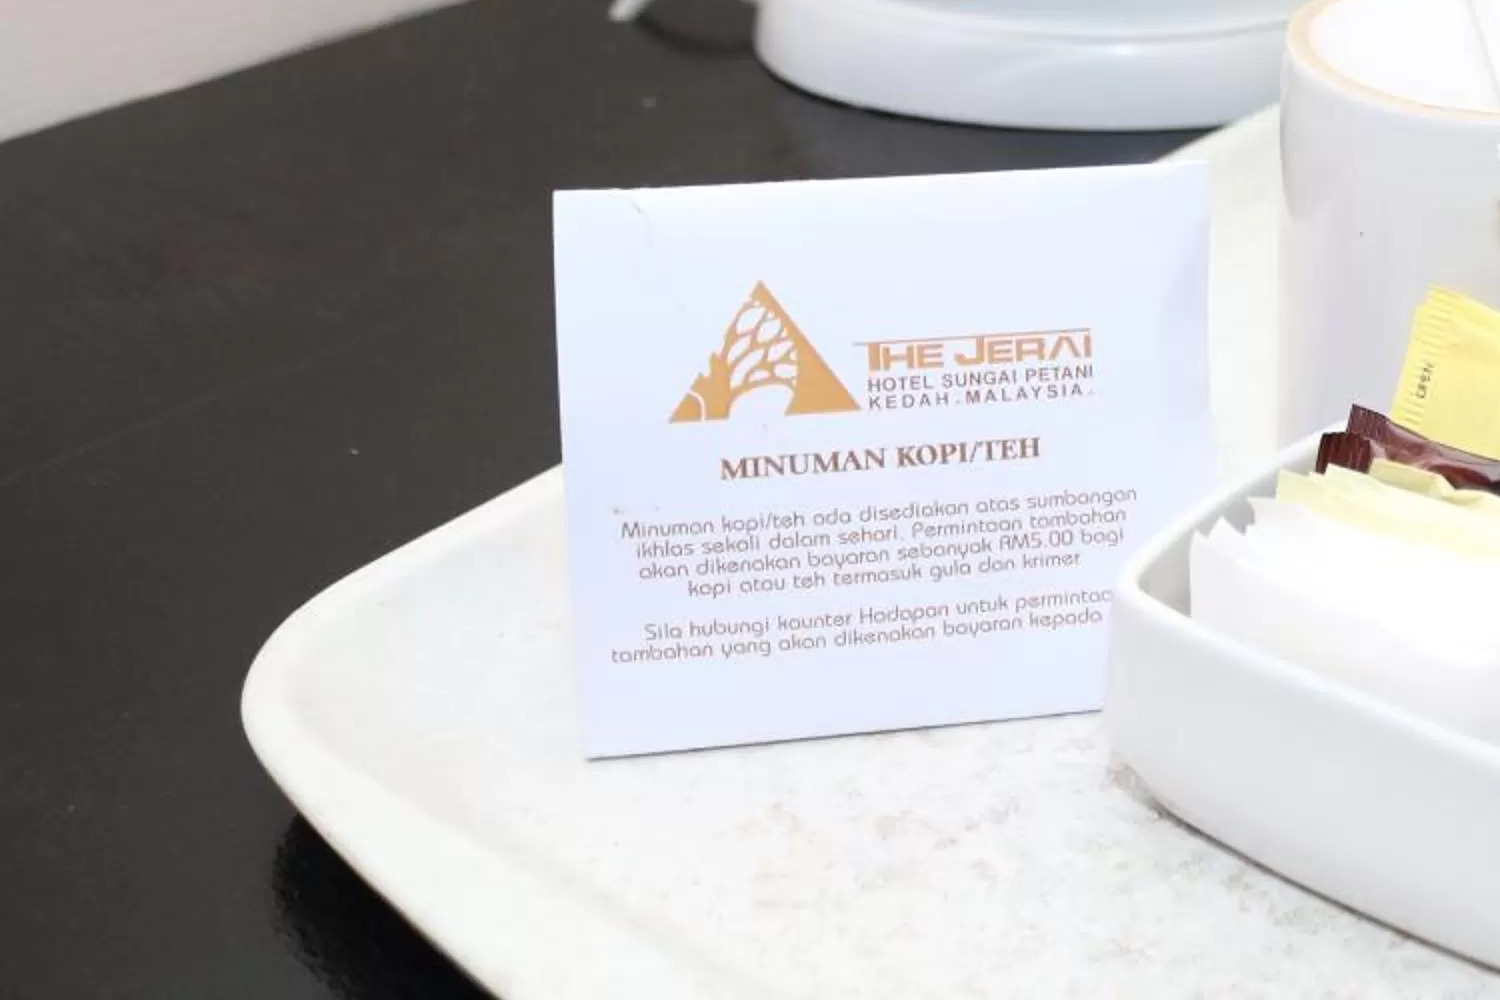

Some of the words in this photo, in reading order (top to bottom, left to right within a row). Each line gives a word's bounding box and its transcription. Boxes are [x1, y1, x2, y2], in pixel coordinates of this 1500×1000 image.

[866, 339, 945, 372] THE
[954, 333, 1091, 366] JERAI
[868, 376, 933, 393] HOTEL
[942, 370, 1016, 389] SUNGAI
[1025, 364, 1093, 383] PETANI
[720, 447, 887, 480] MINUMAN
[897, 437, 1040, 468] KOPI/TEH
[621, 520, 714, 540] Minuman
[722, 512, 805, 535] kopi/teh
[813, 508, 851, 525] ada
[859, 500, 969, 523] disediakan
[976, 497, 1020, 512] atas
[1027, 488, 1137, 510] sumbangan
[636, 539, 694, 559] ikhlas
[701, 535, 761, 555] sekali
[768, 532, 831, 549] dalam
[911, 520, 1022, 539] Permintaan
[1030, 508, 1126, 529] tambahan
[639, 562, 689, 580] akan
[695, 553, 801, 576] dikenakan
[807, 548, 890, 569] bayaran
[897, 536, 992, 560] sebanyak
[999, 529, 1073, 551] RM5.00
[1081, 527, 1124, 547] bagi
[687, 579, 732, 599] kopi
[739, 577, 785, 594] atau
[793, 574, 825, 590] teh
[833, 564, 922, 586] termasuk
[929, 561, 971, 582] gula
[978, 556, 1015, 574] dan
[1023, 550, 1080, 570] krimer
[611, 643, 713, 664] tambahan
[720, 639, 771, 659] yang
[778, 632, 826, 651] akan
[834, 622, 935, 647] dikenakan
[943, 614, 1022, 639] bayaran
[1029, 608, 1103, 631] kepada
[644, 623, 683, 641] Sila
[689, 617, 770, 638] hubungi
[777, 611, 853, 630] kaunter
[859, 603, 949, 626] Hadapan
[956, 595, 1008, 614] untuk
[1015, 588, 1113, 614] permintaa
